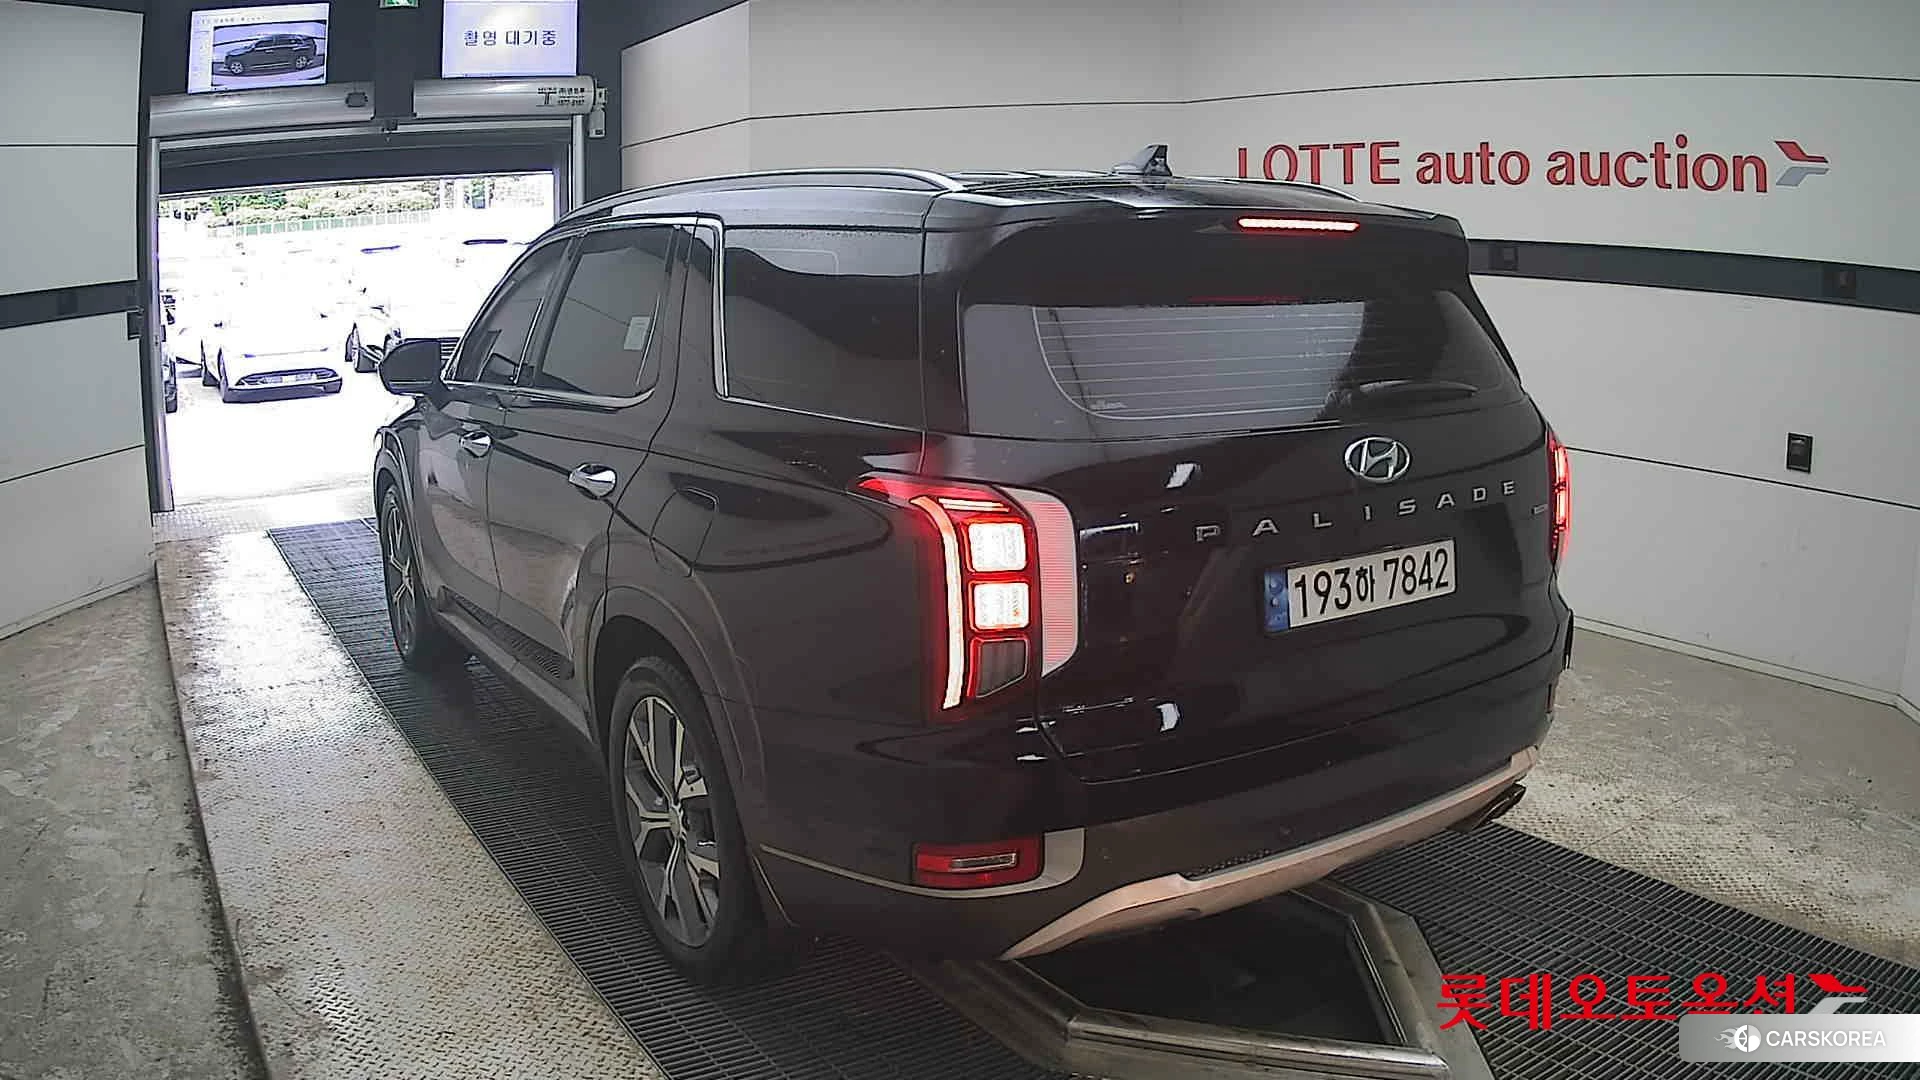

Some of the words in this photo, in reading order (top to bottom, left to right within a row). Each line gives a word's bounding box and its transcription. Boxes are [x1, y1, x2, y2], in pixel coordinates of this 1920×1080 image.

[505, 29, 557, 47] 대기중
[1238, 142, 1401, 185] LOTTE
[1416, 142, 1530, 186] auto
[1546, 134, 1769, 194] auction
[1195, 480, 1517, 543] PALISADE
[1294, 565, 1376, 618] 193하
[1383, 548, 1450, 600] 7842
